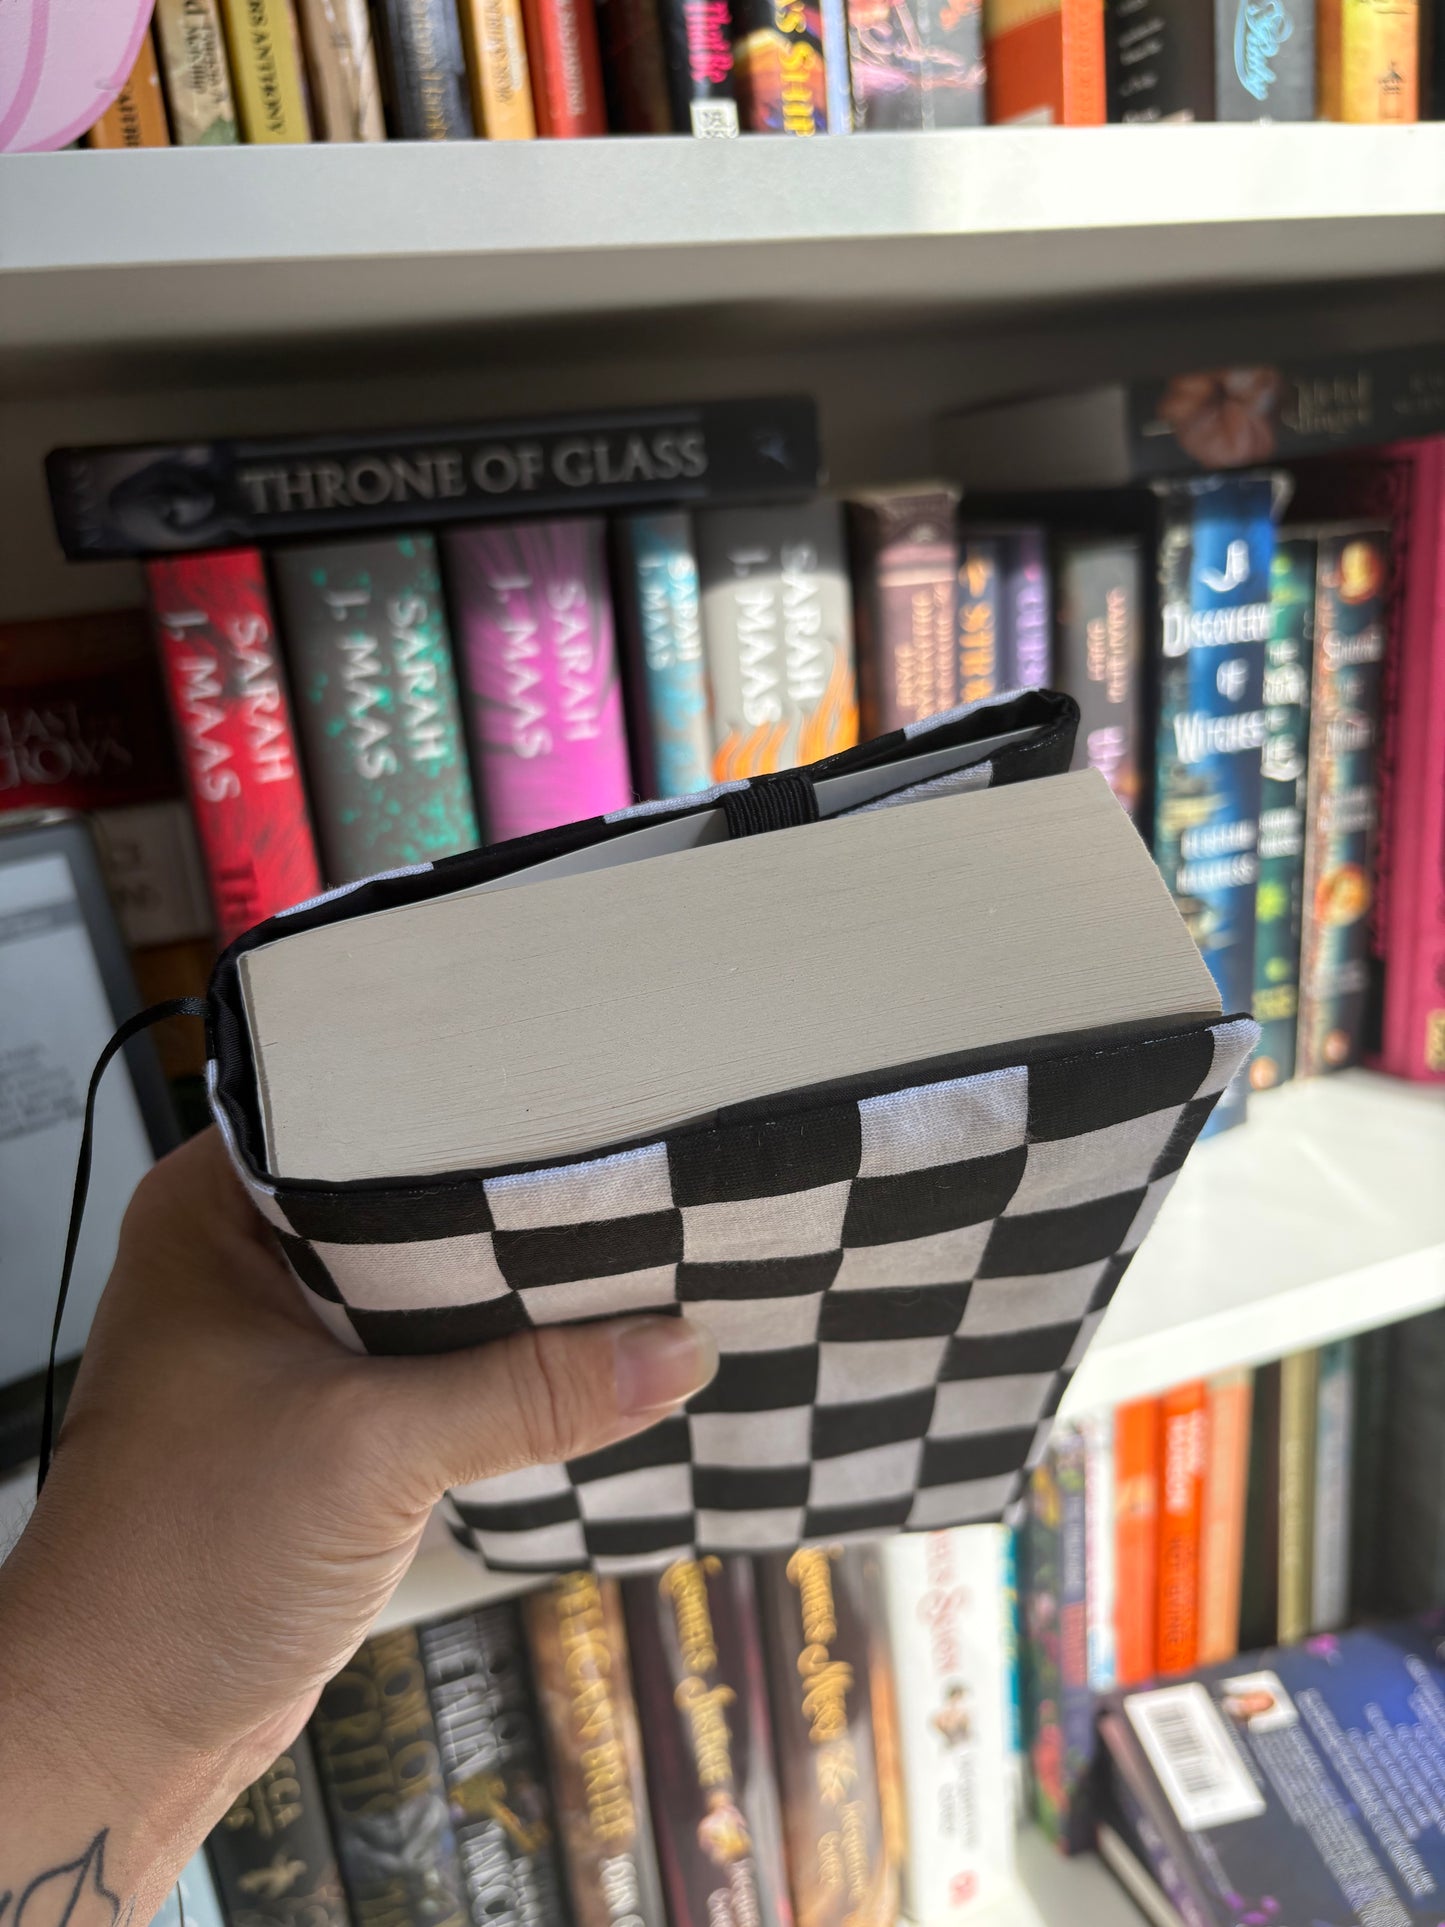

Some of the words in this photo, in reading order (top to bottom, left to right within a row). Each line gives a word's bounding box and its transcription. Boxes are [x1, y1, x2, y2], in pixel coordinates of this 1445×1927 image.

[241, 450, 467, 514] THRONE
[471, 440, 545, 494] OF
[552, 430, 709, 488] GLASS
[386, 595, 448, 762] SARAH
[500, 620, 554, 759] MAAS
[546, 580, 600, 742] SARAH
[734, 587, 783, 726] MAAS
[780, 541, 826, 700] SARAH
[176, 655, 241, 802] MAAS
[227, 613, 295, 784] SARAH
[336, 635, 398, 780] MAAS
